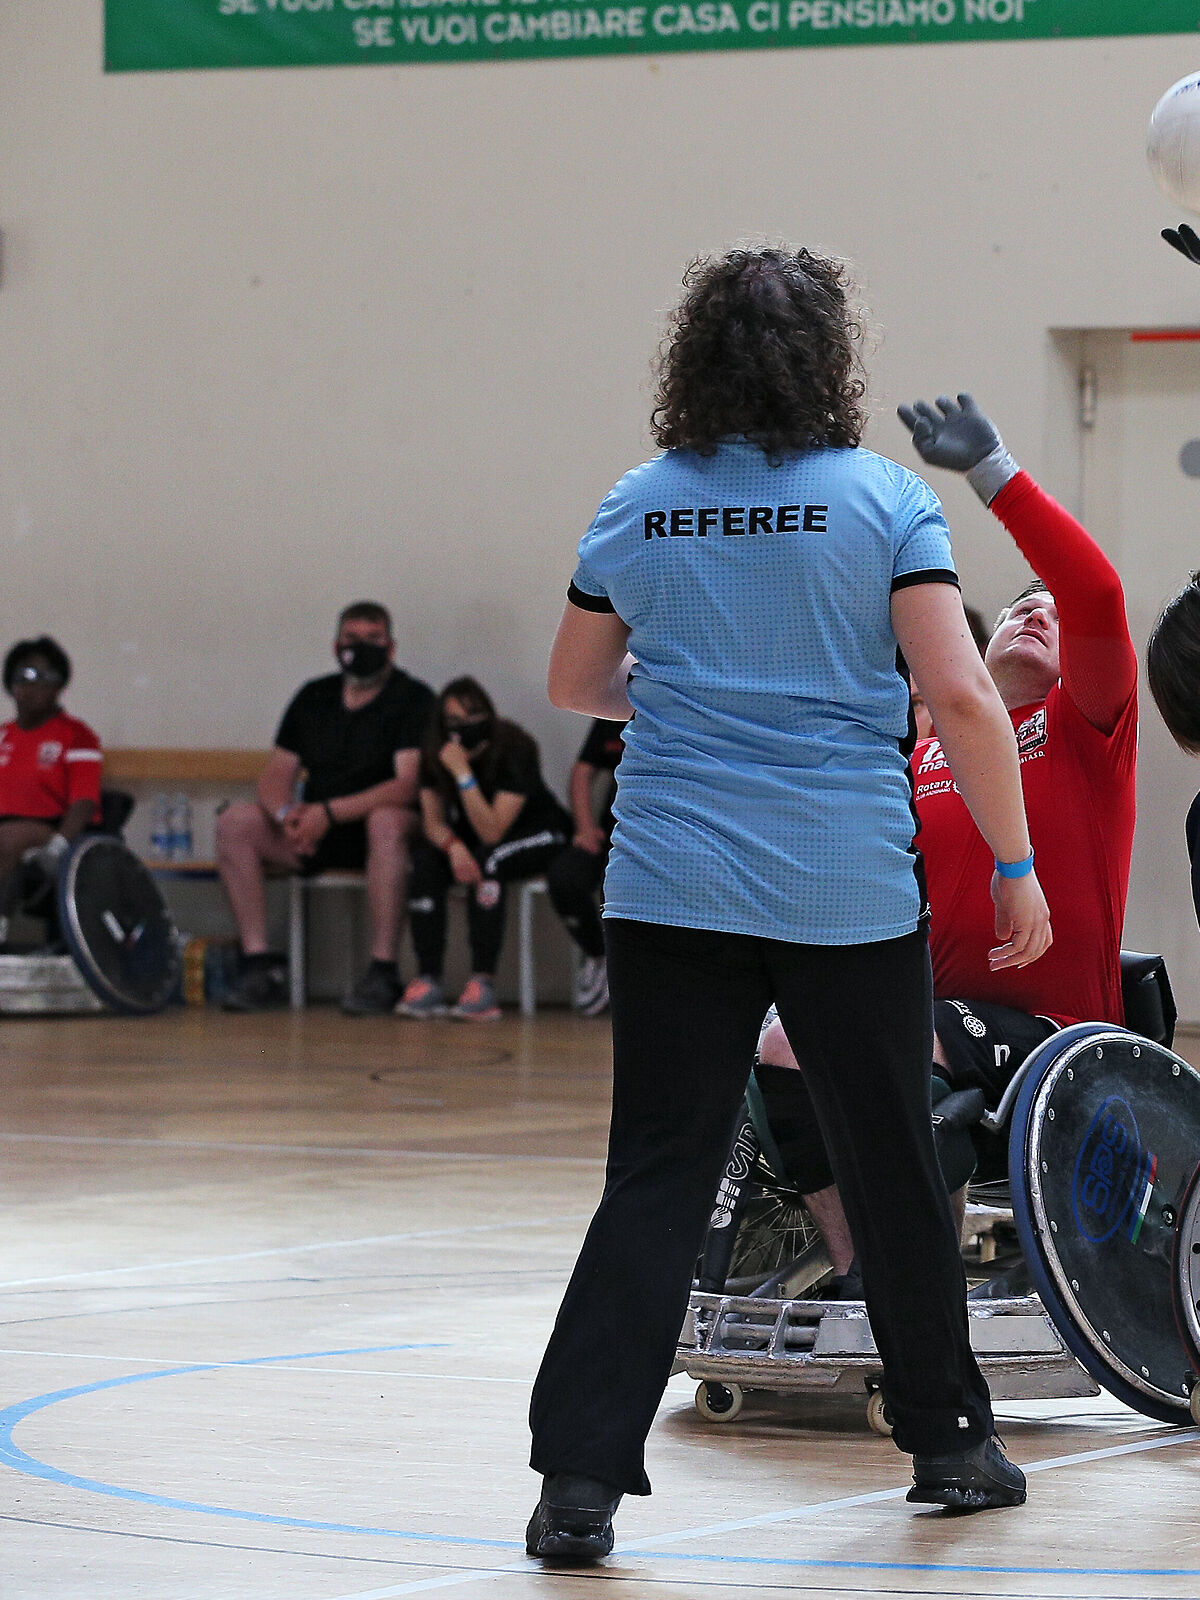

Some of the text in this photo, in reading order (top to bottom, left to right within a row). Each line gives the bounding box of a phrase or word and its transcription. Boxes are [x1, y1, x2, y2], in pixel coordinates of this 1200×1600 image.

[352, 16, 395, 47] SE
[401, 14, 478, 45] VUOI
[484, 7, 648, 43] CAMBIARE
[652, 4, 741, 36] CASA
[747, 3, 780, 31] CI
[788, 0, 956, 30] PENSIAMO
[644, 504, 829, 541] REFEREE
[916, 779, 952, 795] Rotary
